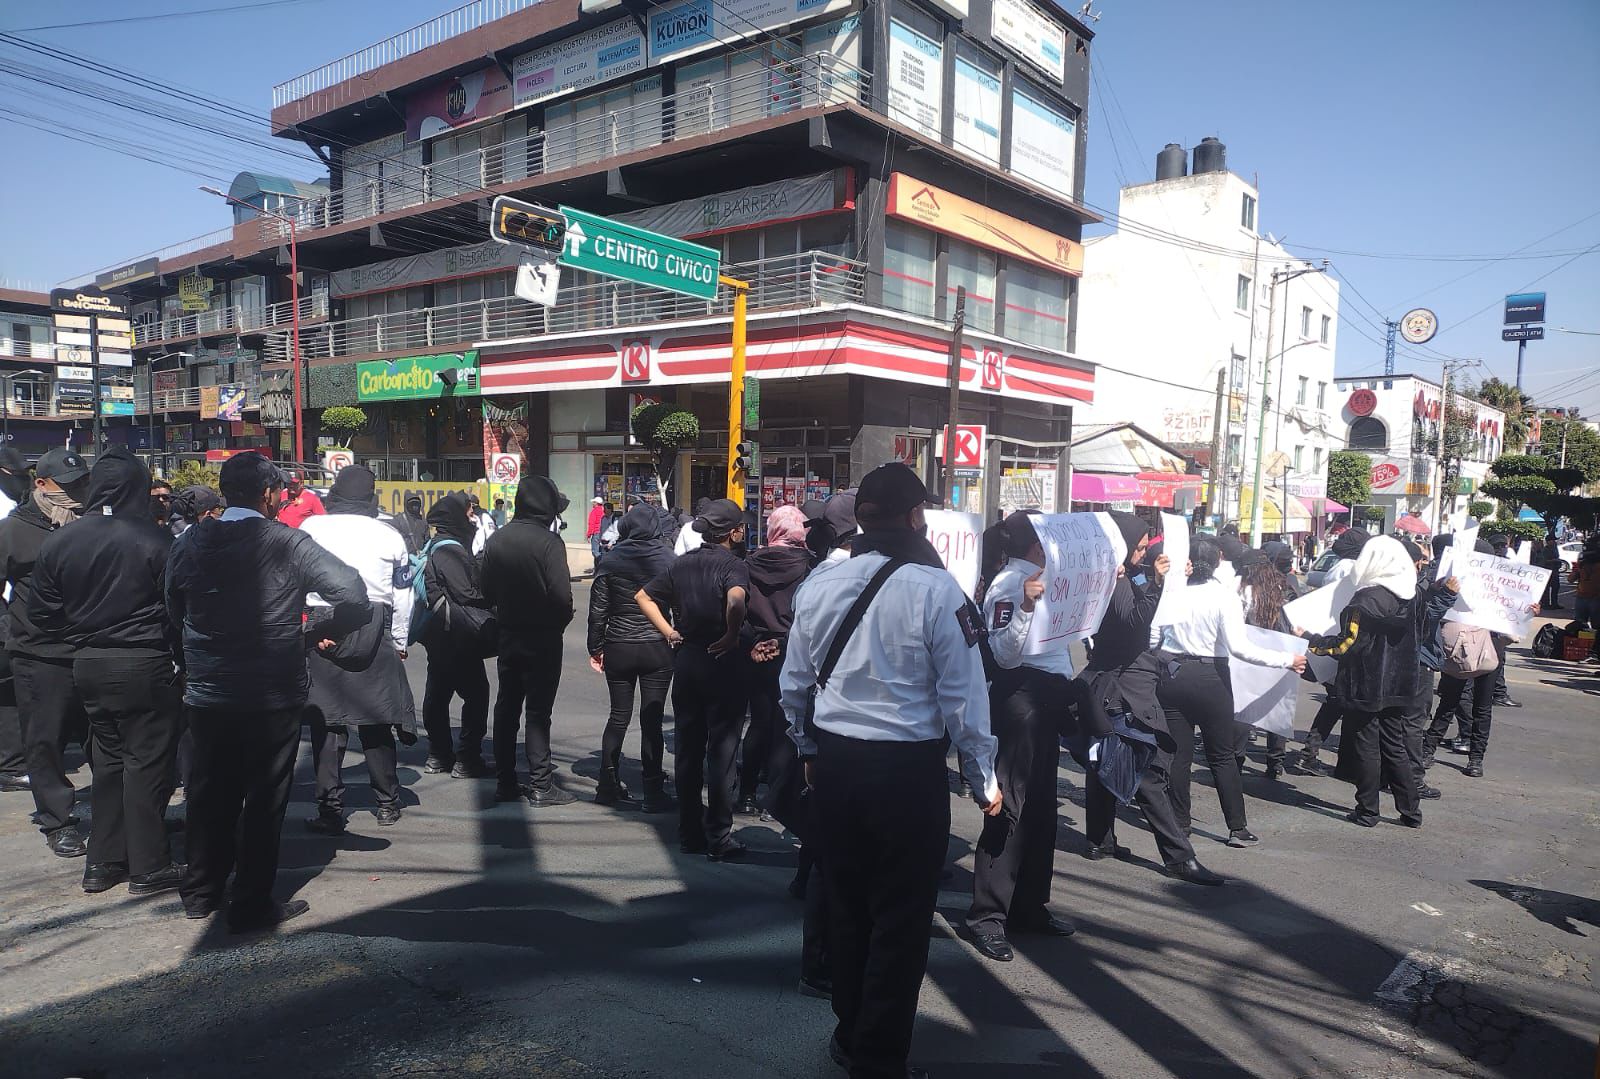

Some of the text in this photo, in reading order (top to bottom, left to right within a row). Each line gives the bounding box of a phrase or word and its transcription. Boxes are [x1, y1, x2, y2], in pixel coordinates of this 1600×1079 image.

[656, 12, 709, 42] KUMON
[724, 191, 789, 218] BARRERA
[459, 247, 501, 267] BARRERA
[594, 235, 713, 284] CENTRO CIVICO
[629, 347, 645, 374] K
[360, 363, 433, 395] Carboncito
[485, 405, 525, 421] BUFFET
[954, 433, 978, 458] K
[1371, 466, 1395, 483] 75%
[1079, 544, 1091, 568] de
[1051, 576, 1070, 602] SIN
[1000, 609, 1011, 623] E
